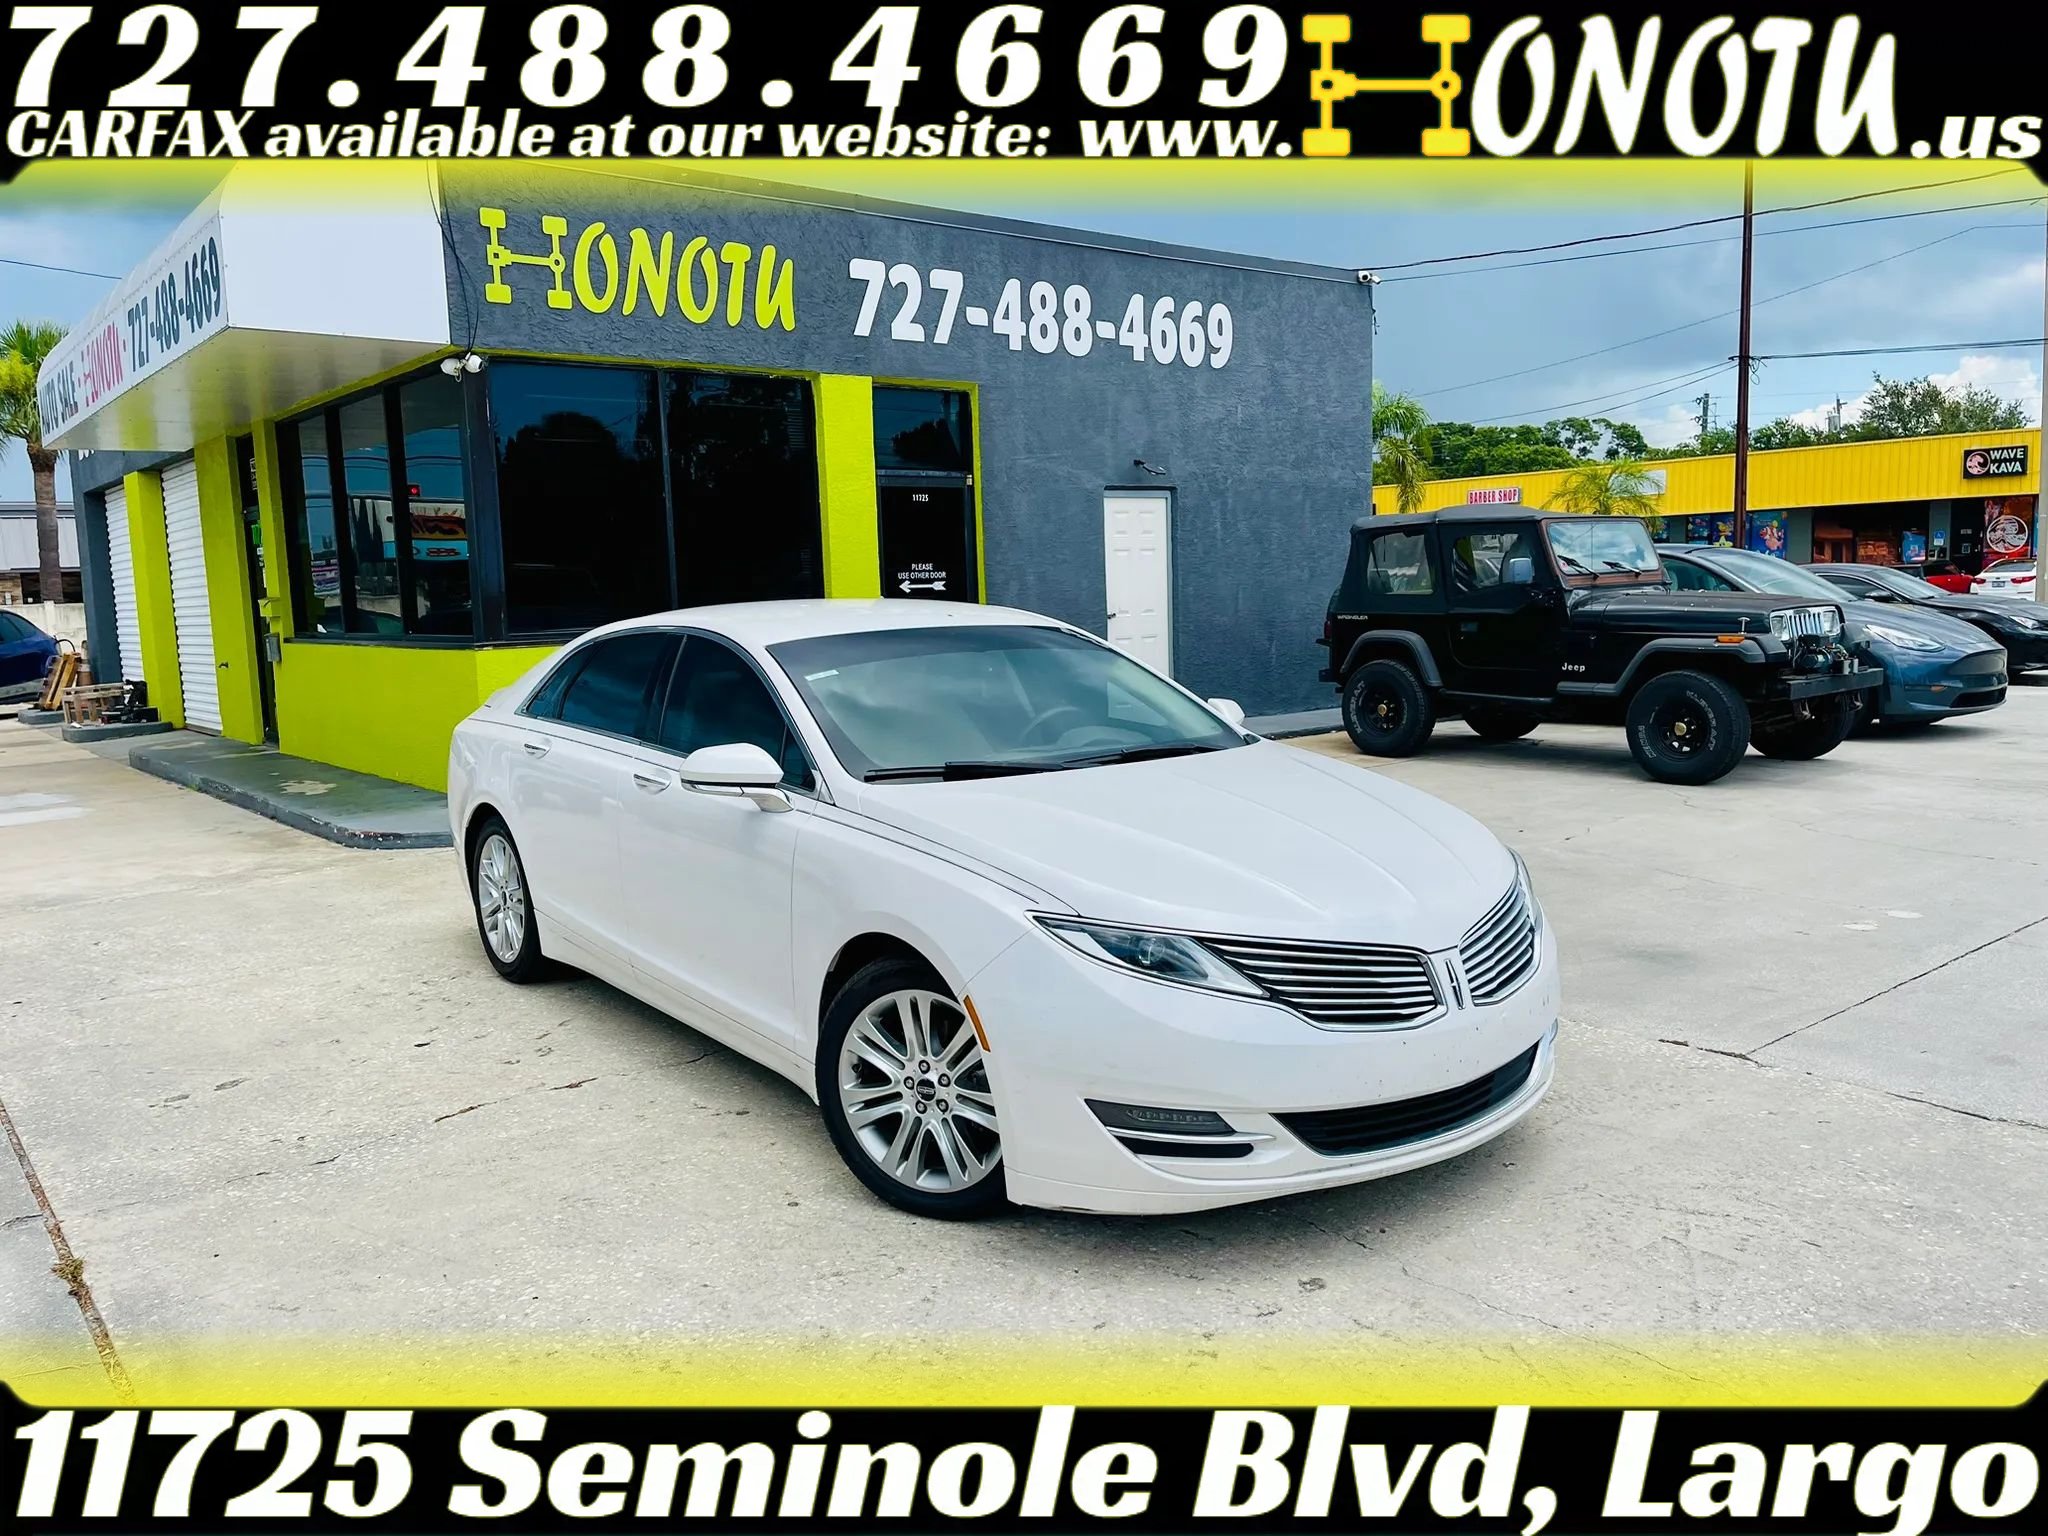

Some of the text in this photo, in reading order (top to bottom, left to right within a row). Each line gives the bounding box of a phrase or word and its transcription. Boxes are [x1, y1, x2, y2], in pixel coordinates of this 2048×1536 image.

[849, 257, 1235, 369] 727-488-4669
[40, 378, 59, 437] AUTO
[58, 360, 79, 424] SALE
[127, 236, 221, 372] 727-488-4669
[1989, 447, 2025, 460] WAVE
[1989, 461, 2023, 475] KAVA
[912, 494, 929, 502] 11725
[1470, 489, 1517, 504] BARBER SHOP
[911, 563, 934, 571] PLEASE
[898, 571, 947, 580] USE OTHER DOOR
[1561, 662, 1586, 673] Jeep
